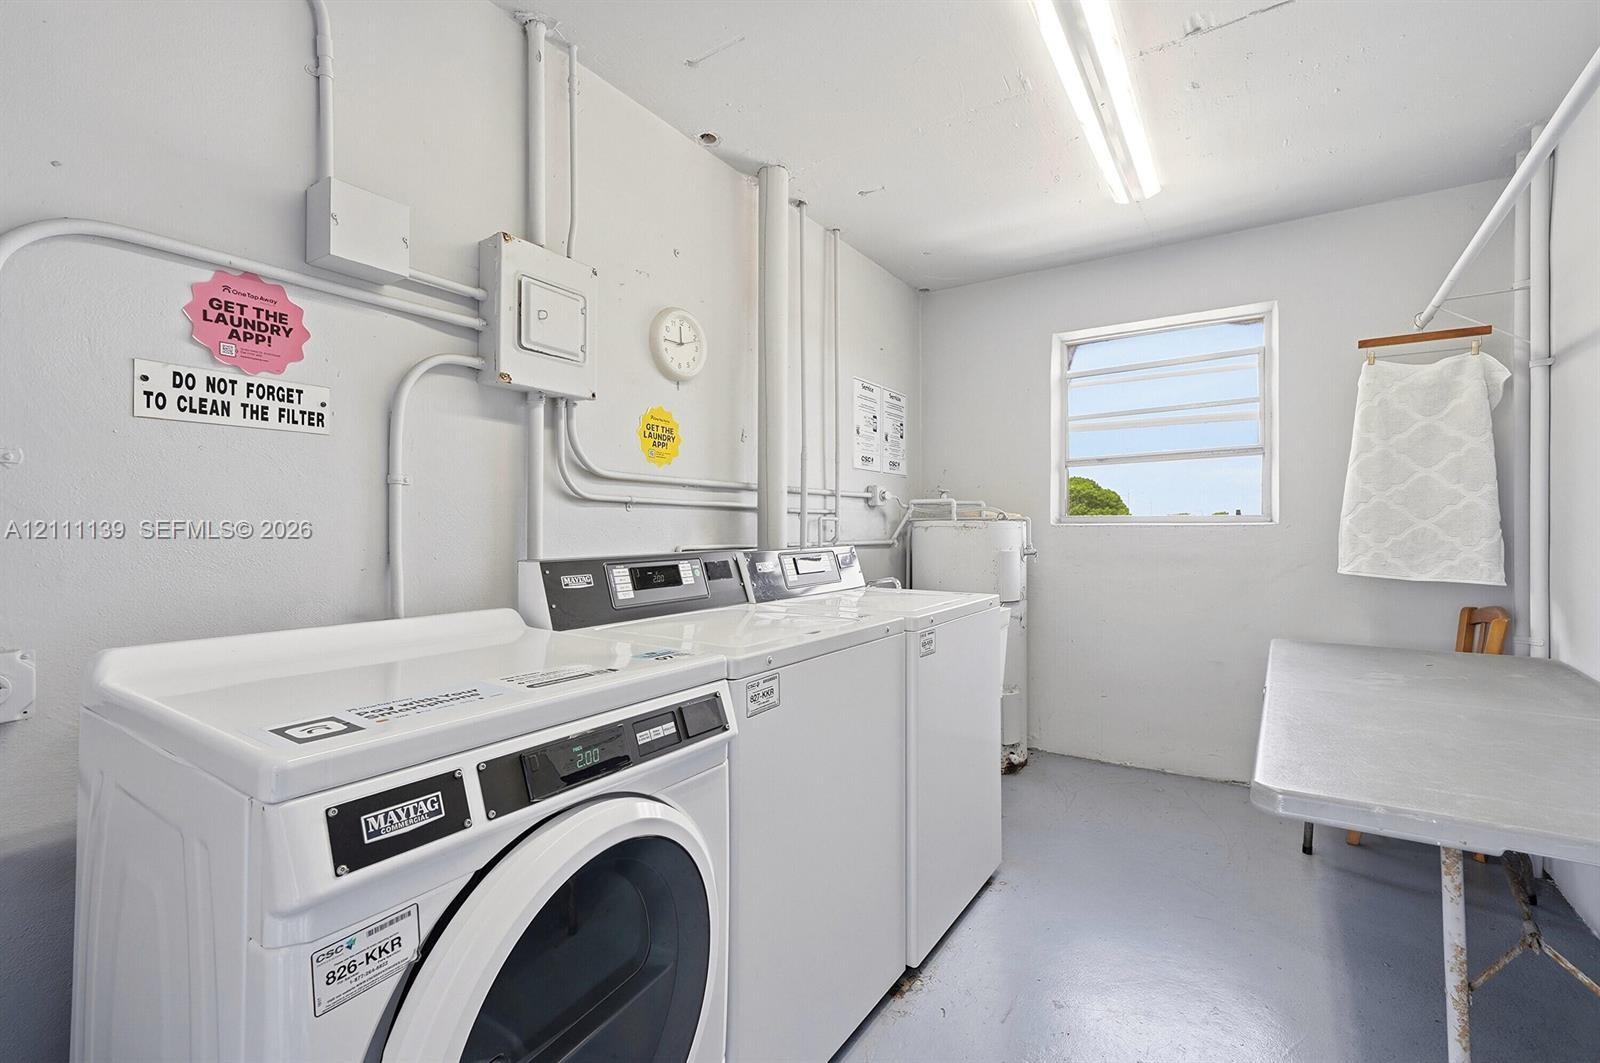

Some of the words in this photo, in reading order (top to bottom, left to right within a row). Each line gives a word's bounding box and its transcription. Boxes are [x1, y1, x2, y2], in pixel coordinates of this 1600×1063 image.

[208, 298, 248, 316] GET
[252, 306, 288, 325] THE
[202, 310, 293, 338] LAUNDRY
[228, 329, 272, 347] APP!
[172, 371, 196, 390] DO
[206, 376, 238, 396] NOT
[247, 382, 304, 405] FORGET
[143, 391, 166, 410] TO
[177, 395, 231, 417] CLEAN
[241, 403, 269, 421] THE
[278, 408, 325, 428] FILTER
[643, 431, 676, 443] LAUNDRY
[646, 423, 659, 432] GET
[661, 426, 674, 435] THE
[652, 440, 668, 449] APP!
[564, 576, 591, 584] MAYTAG
[355, 706, 394, 716] Pay
[398, 697, 435, 707] with
[437, 688, 479, 698] Your
[364, 693, 481, 719] Smartphone
[576, 748, 599, 768] 2.00
[366, 797, 439, 833] MAYTAG
[380, 814, 430, 835] COMMERCIAL
[316, 944, 344, 963] CSC
[326, 936, 402, 986] 826-KKR
